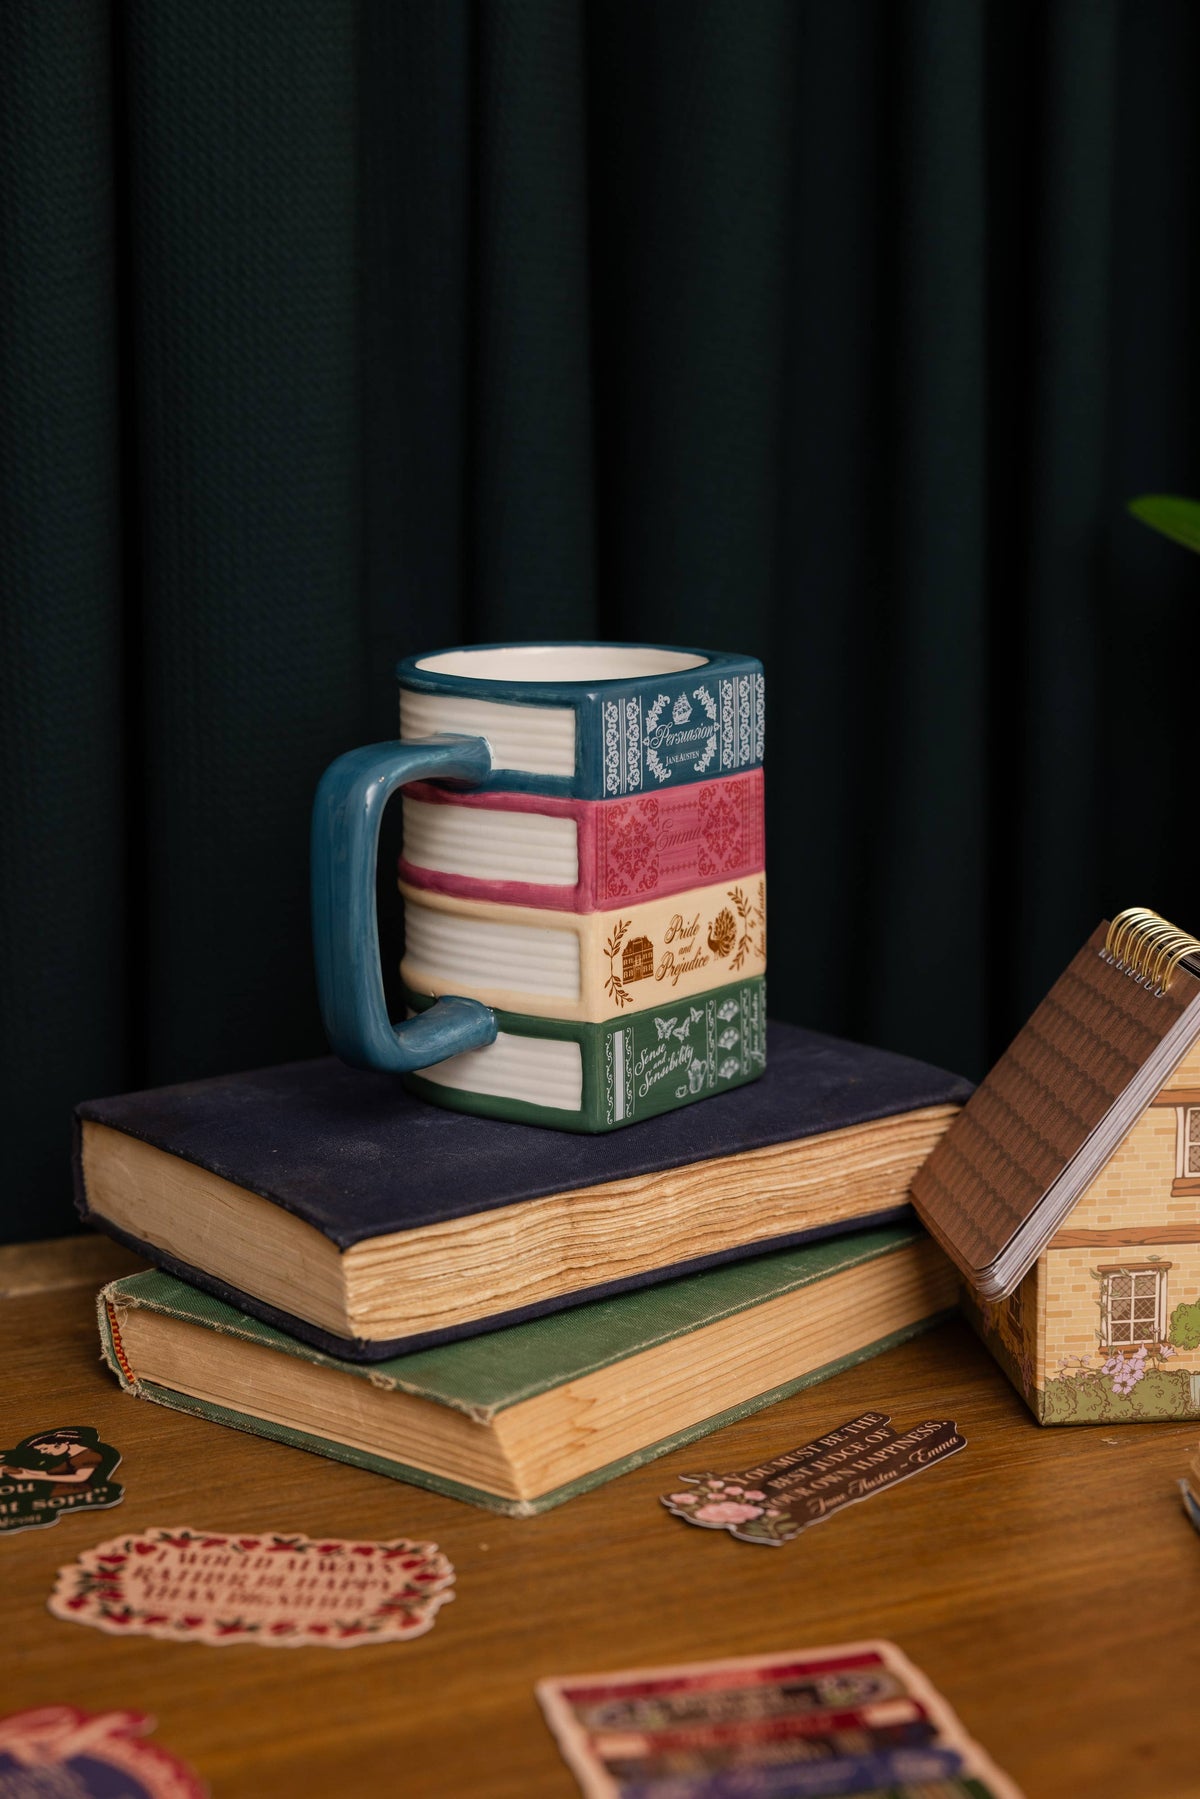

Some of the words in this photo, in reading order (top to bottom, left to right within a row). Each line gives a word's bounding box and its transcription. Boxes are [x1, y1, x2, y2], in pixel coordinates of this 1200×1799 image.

[650, 722, 714, 749] Persuasion
[665, 755, 680, 767] JANE
[680, 751, 700, 762] AUSTEN
[664, 912, 700, 944] Pride
[678, 937, 696, 955] and
[655, 946, 710, 986] Prejudice
[634, 1043, 667, 1076] Sense
[639, 1044, 694, 1098] Sensibility
[653, 1051, 667, 1069] and
[723, 1465, 776, 1485] YOU
[771, 1444, 822, 1468] MUST
[819, 1432, 849, 1447] BE
[841, 1413, 883, 1434] THE
[767, 1467, 814, 1489] BEST
[811, 1441, 871, 1472] JUDGE
[864, 1428, 891, 1443] OF
[810, 1467, 857, 1489] OWN
[852, 1421, 948, 1470] HAPPINESS.
[908, 1436, 959, 1463] Emma
